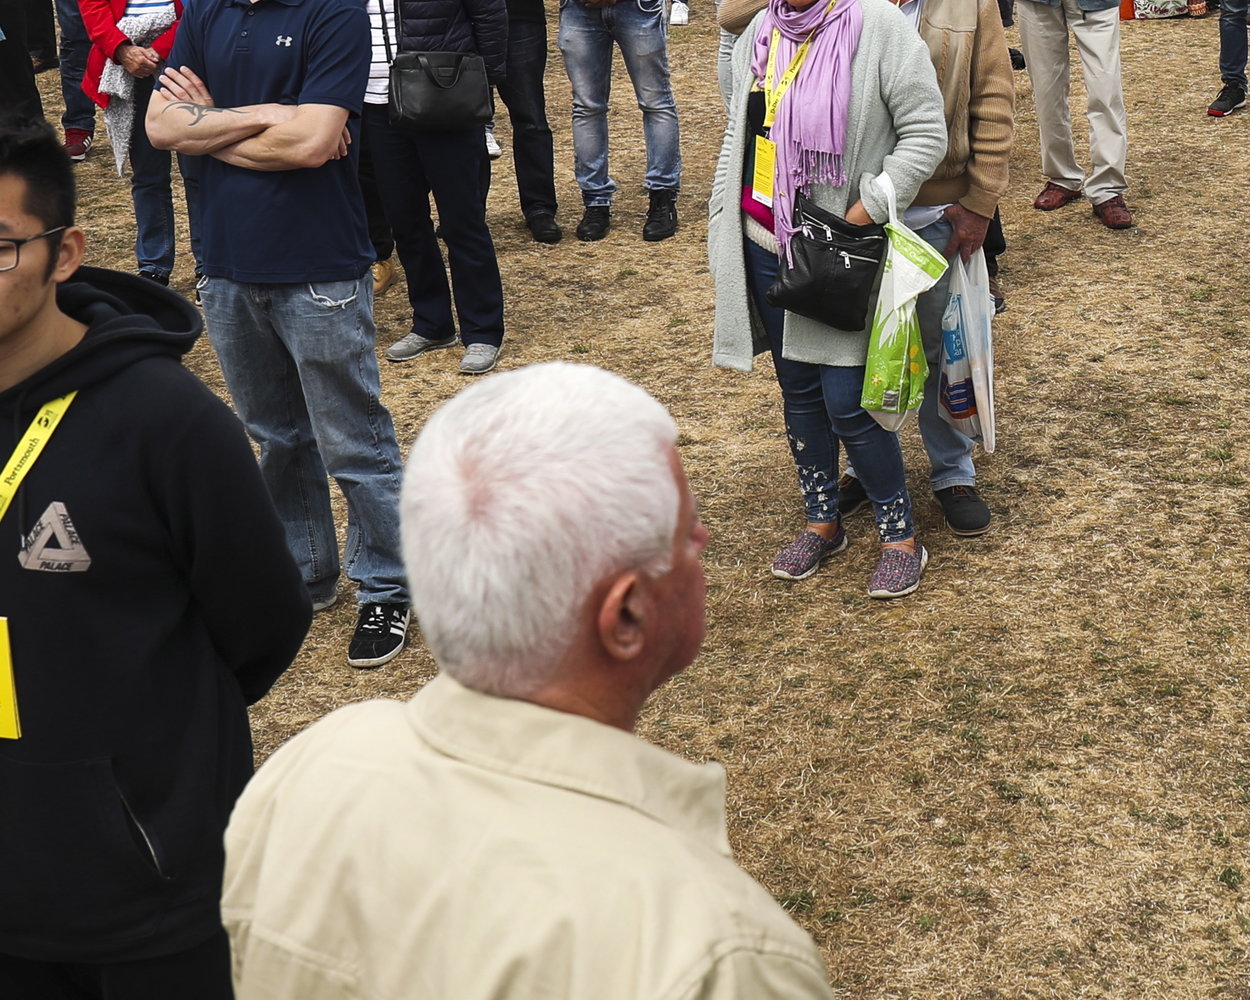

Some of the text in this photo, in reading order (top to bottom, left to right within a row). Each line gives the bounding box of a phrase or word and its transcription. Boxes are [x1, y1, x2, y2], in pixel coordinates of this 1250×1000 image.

[4, 437, 40, 486] Portsmouth
[59, 513, 81, 545] PALACE
[40, 561, 74, 570] PALACE
